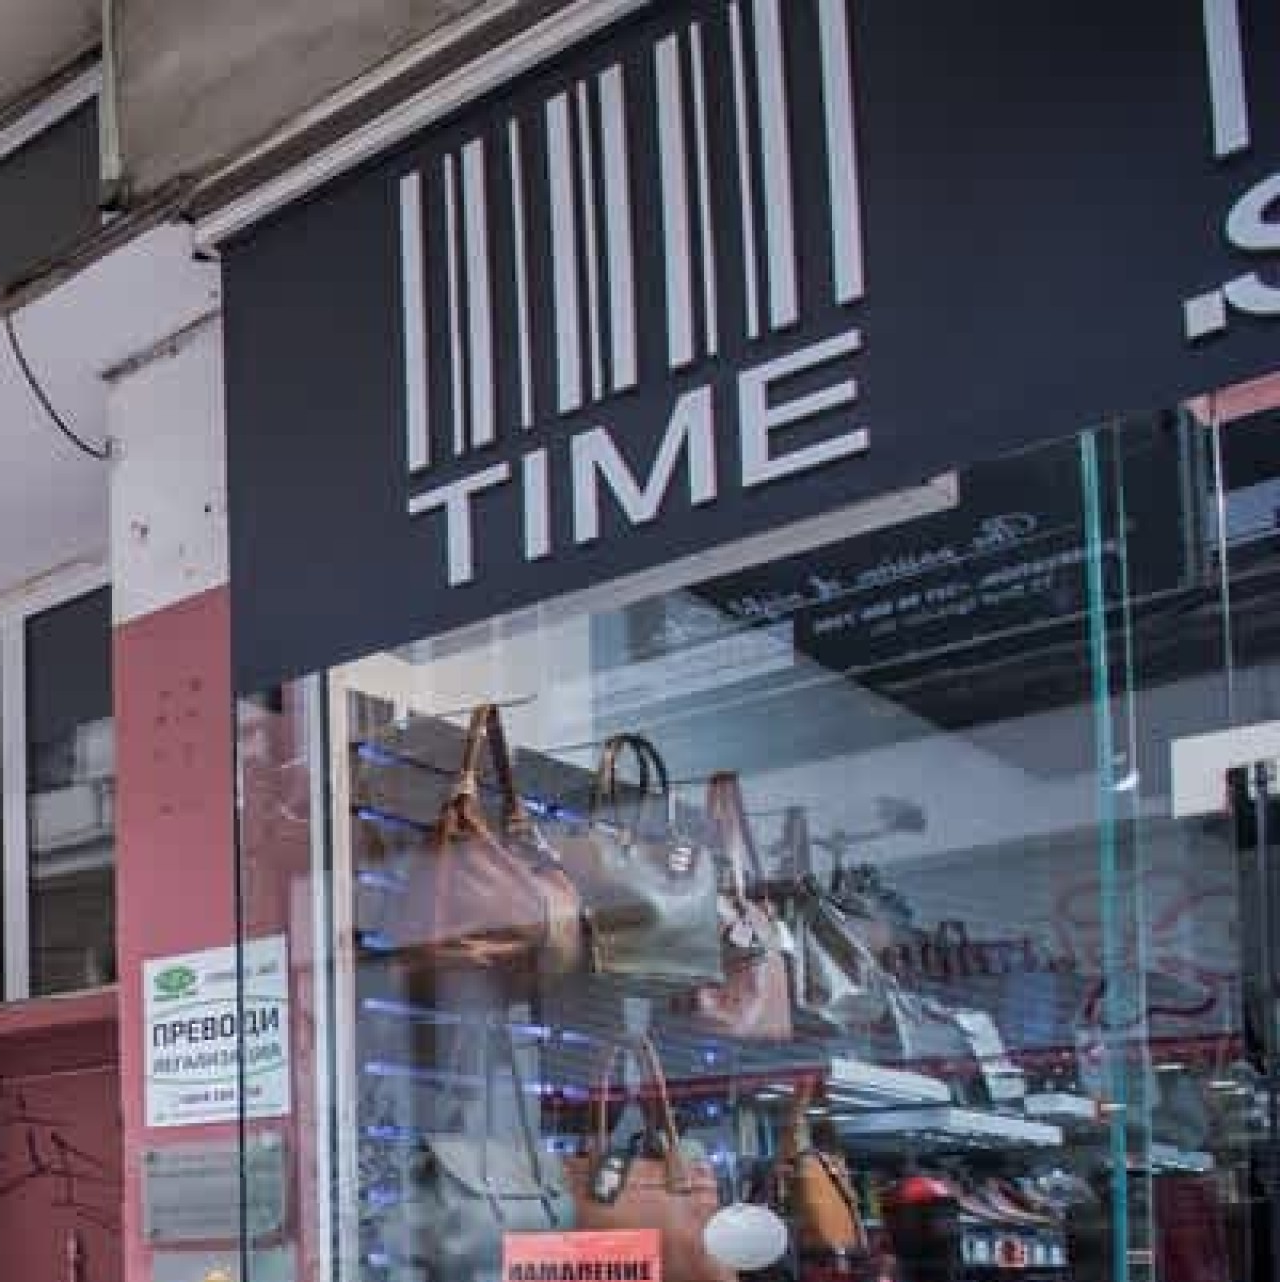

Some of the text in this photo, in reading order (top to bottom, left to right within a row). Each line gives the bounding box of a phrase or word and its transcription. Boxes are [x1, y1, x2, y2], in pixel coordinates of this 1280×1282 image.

[408, 329, 871, 587] TIME
[153, 1007, 279, 1047] ПРЕВОДИ
[508, 1260, 652, 1281] НАМАЛЕНИЕ
